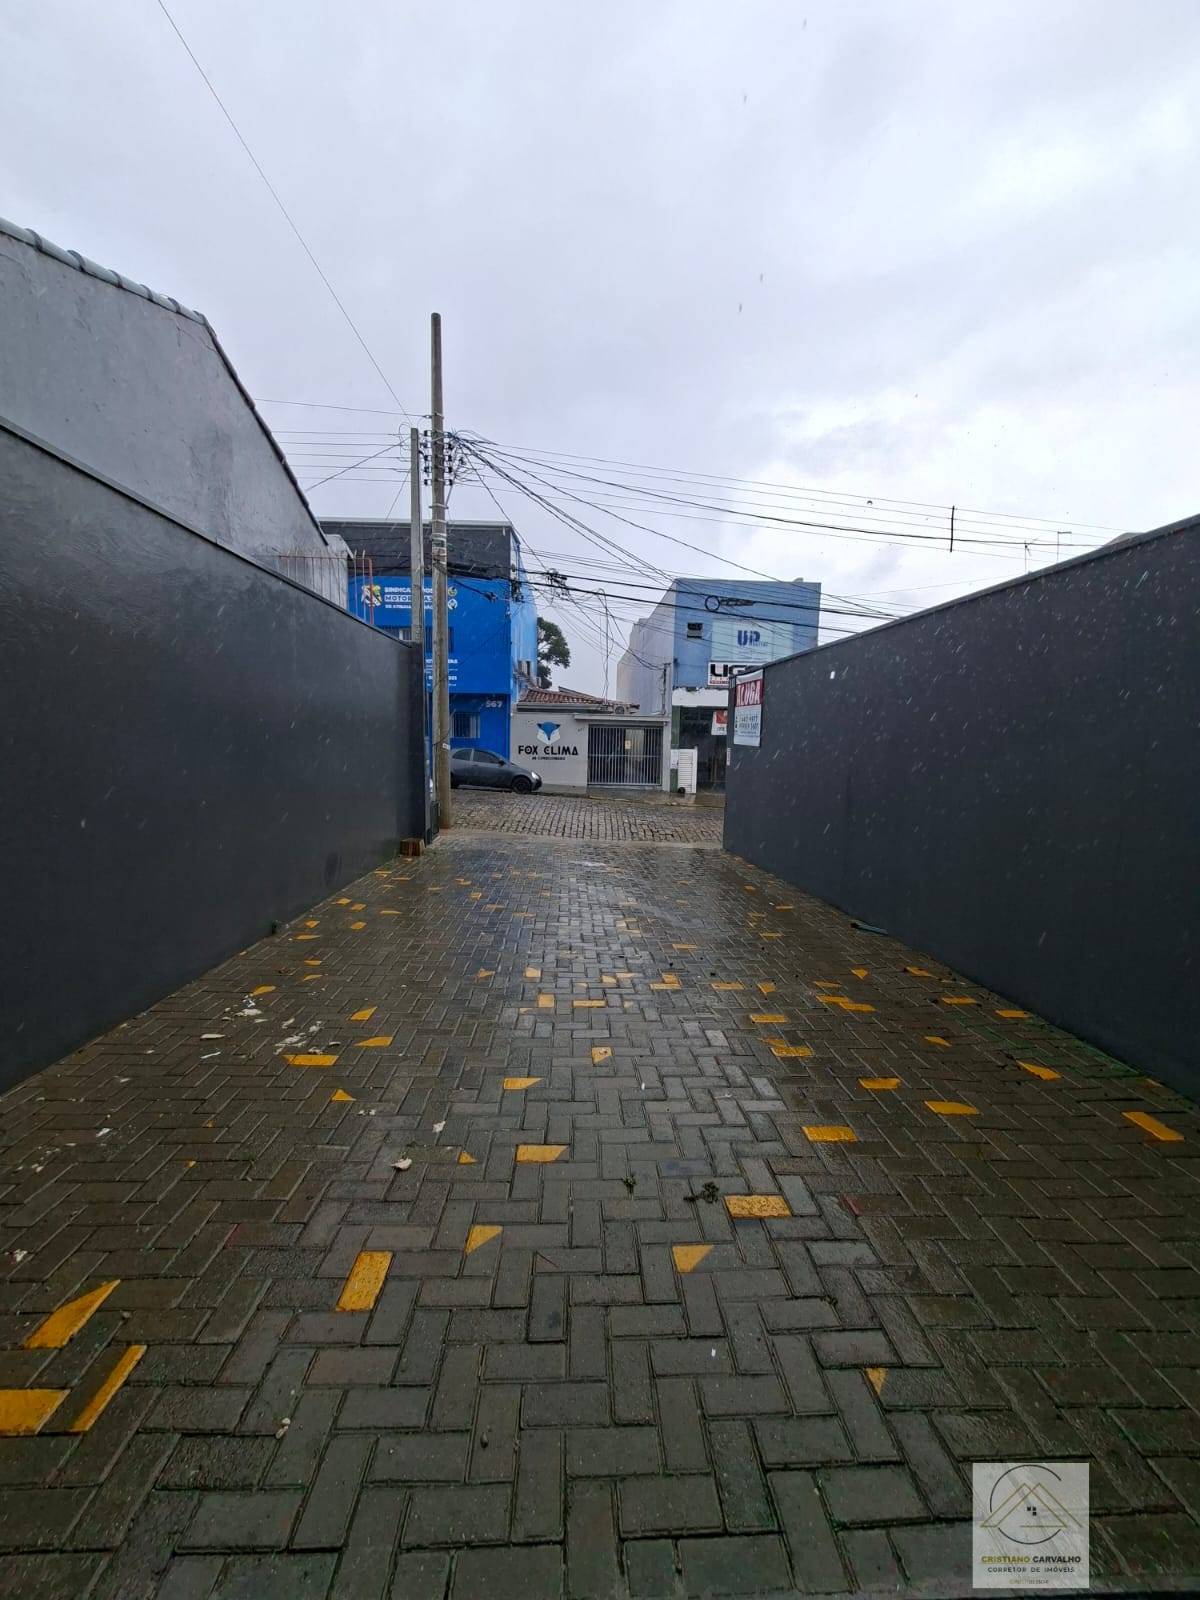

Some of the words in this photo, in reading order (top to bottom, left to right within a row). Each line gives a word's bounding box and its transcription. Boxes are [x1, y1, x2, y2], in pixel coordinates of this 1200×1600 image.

[736, 680, 761, 707] ALUGA
[518, 745, 538, 755] FOX
[543, 745, 579, 756] CLIMA
